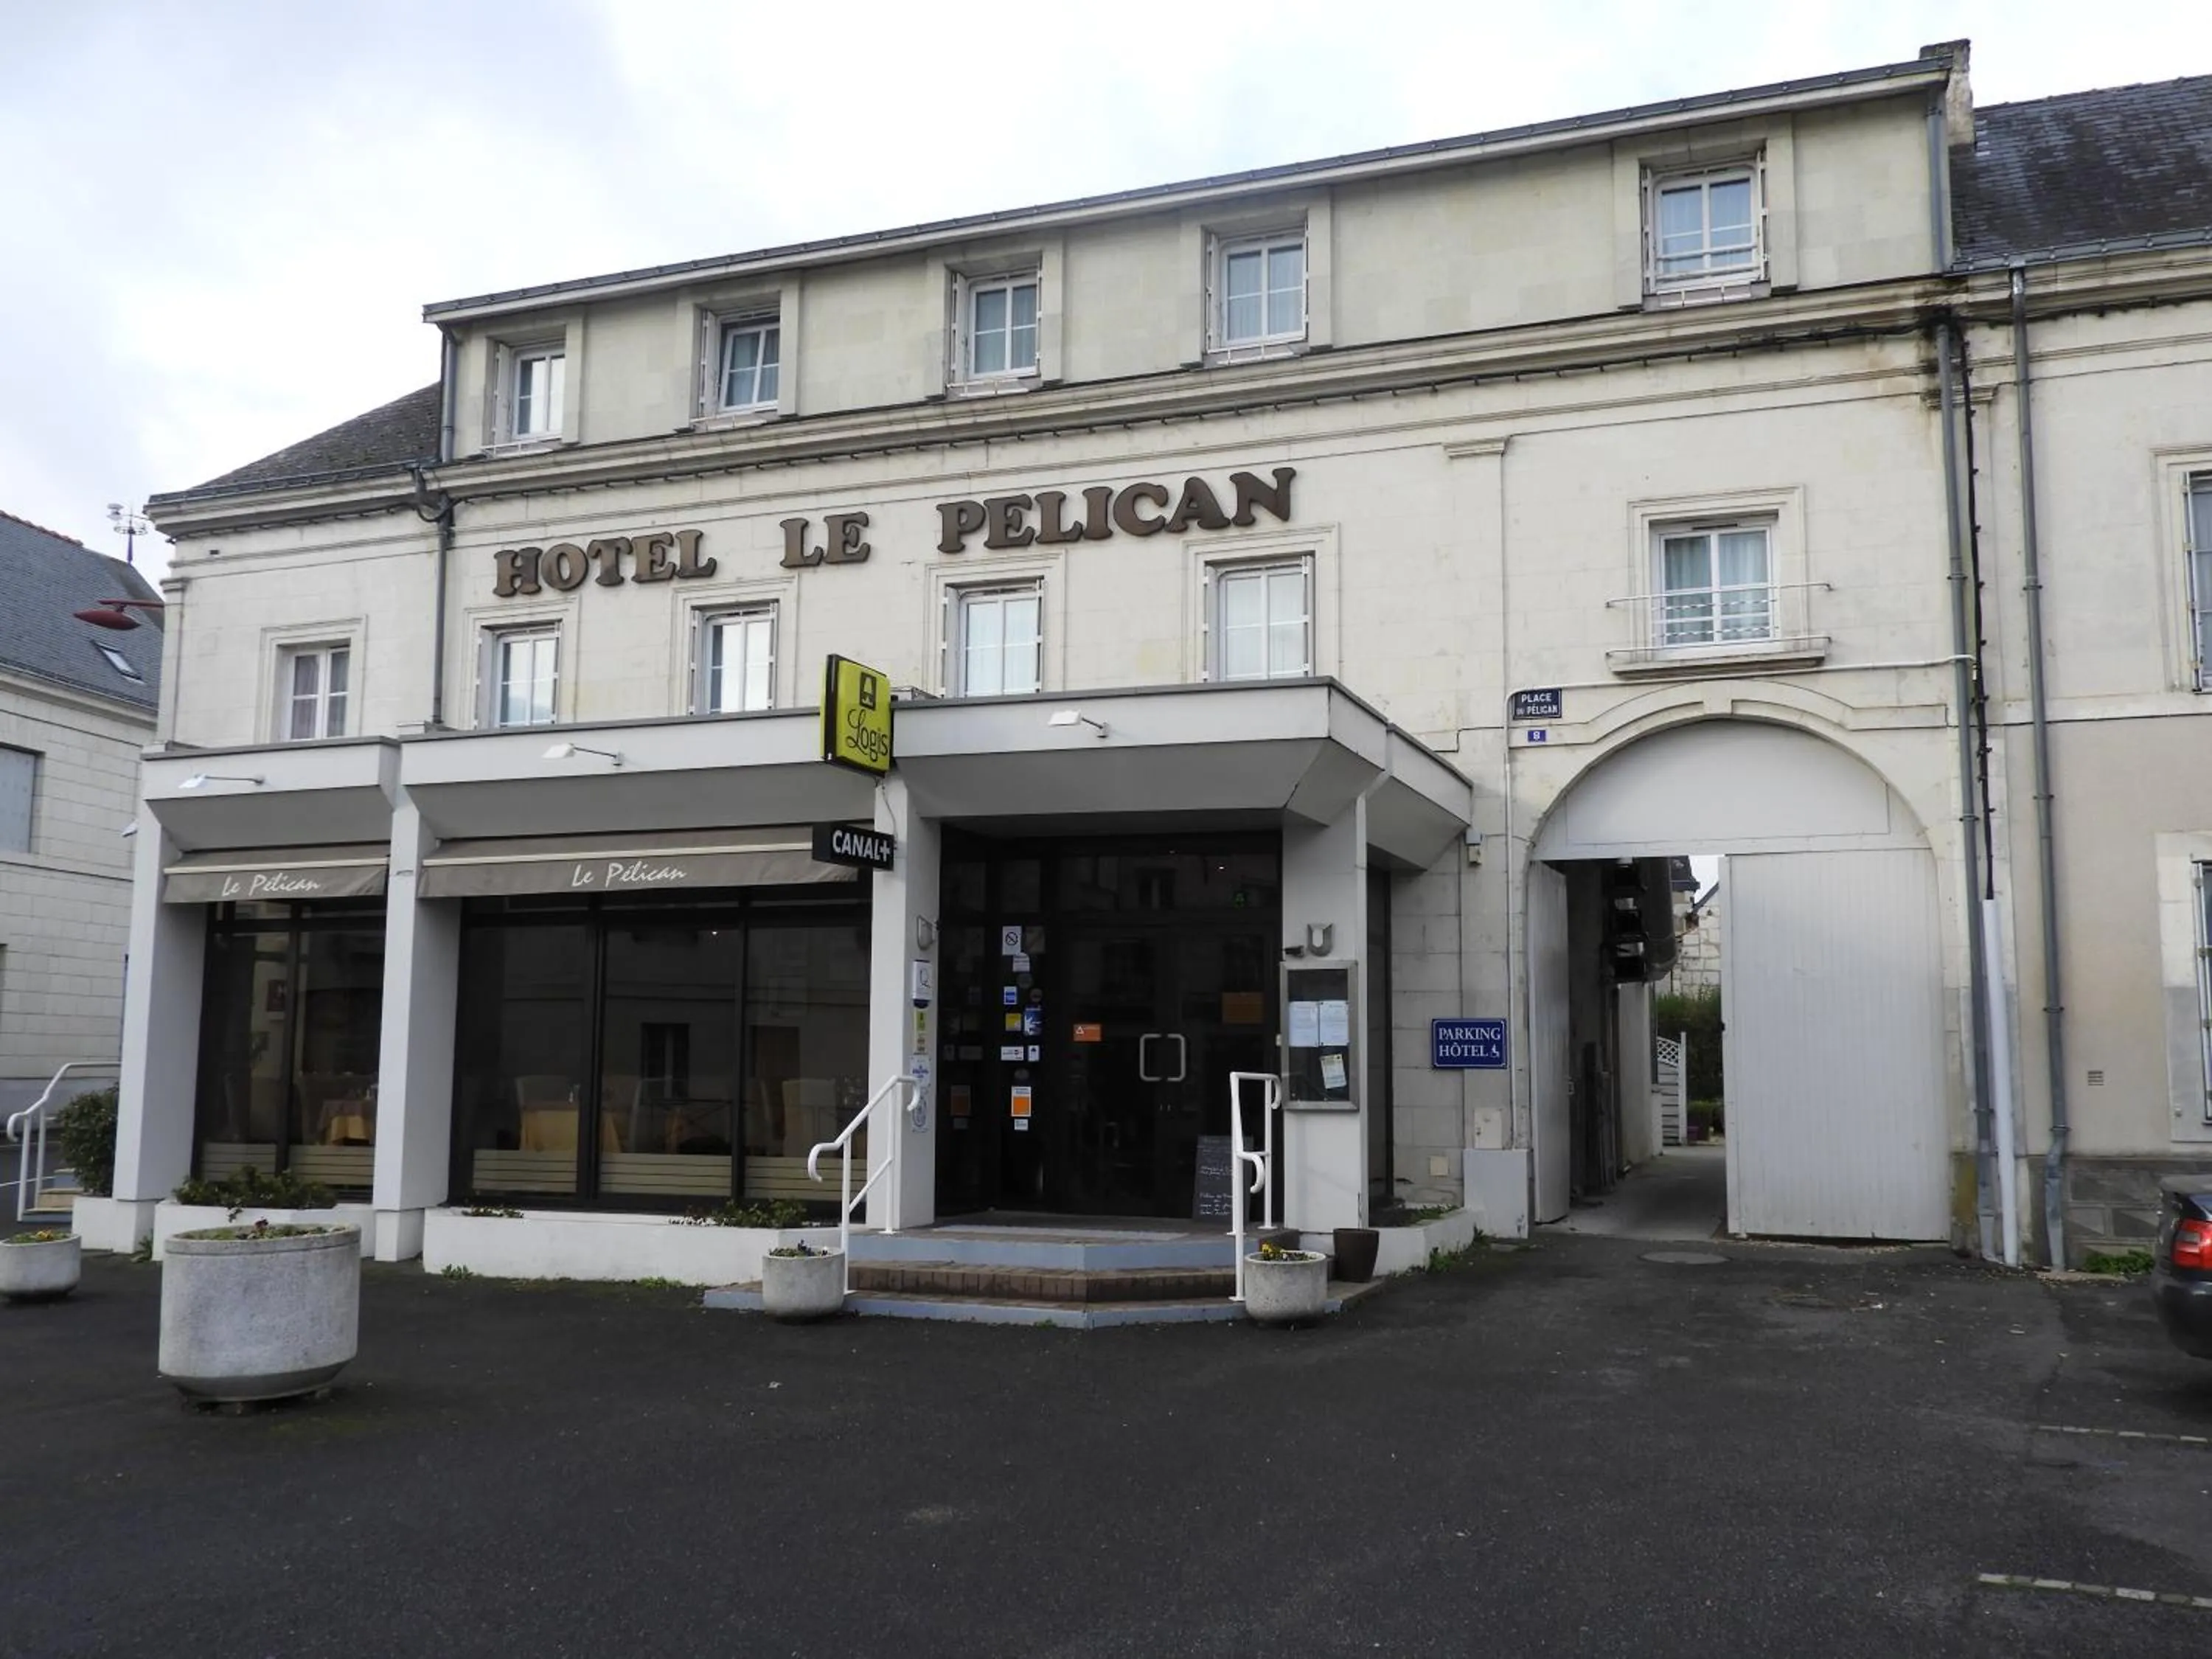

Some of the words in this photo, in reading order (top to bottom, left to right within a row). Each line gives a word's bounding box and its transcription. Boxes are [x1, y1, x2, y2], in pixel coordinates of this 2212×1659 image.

[493, 529, 717, 597] HOTEL
[779, 511, 872, 568] LE
[936, 467, 1297, 554] PELICAN
[1521, 692, 1552, 703] PLACE
[845, 709, 888, 762] Logis
[832, 830, 891, 863] CANAL+
[222, 875, 240, 897] Le
[248, 872, 322, 897] Pélican
[571, 863, 594, 888] Le
[605, 860, 687, 888] Pélican
[1439, 1027, 1500, 1040] PARKING
[1439, 1042, 1489, 1057] HÔTEL
